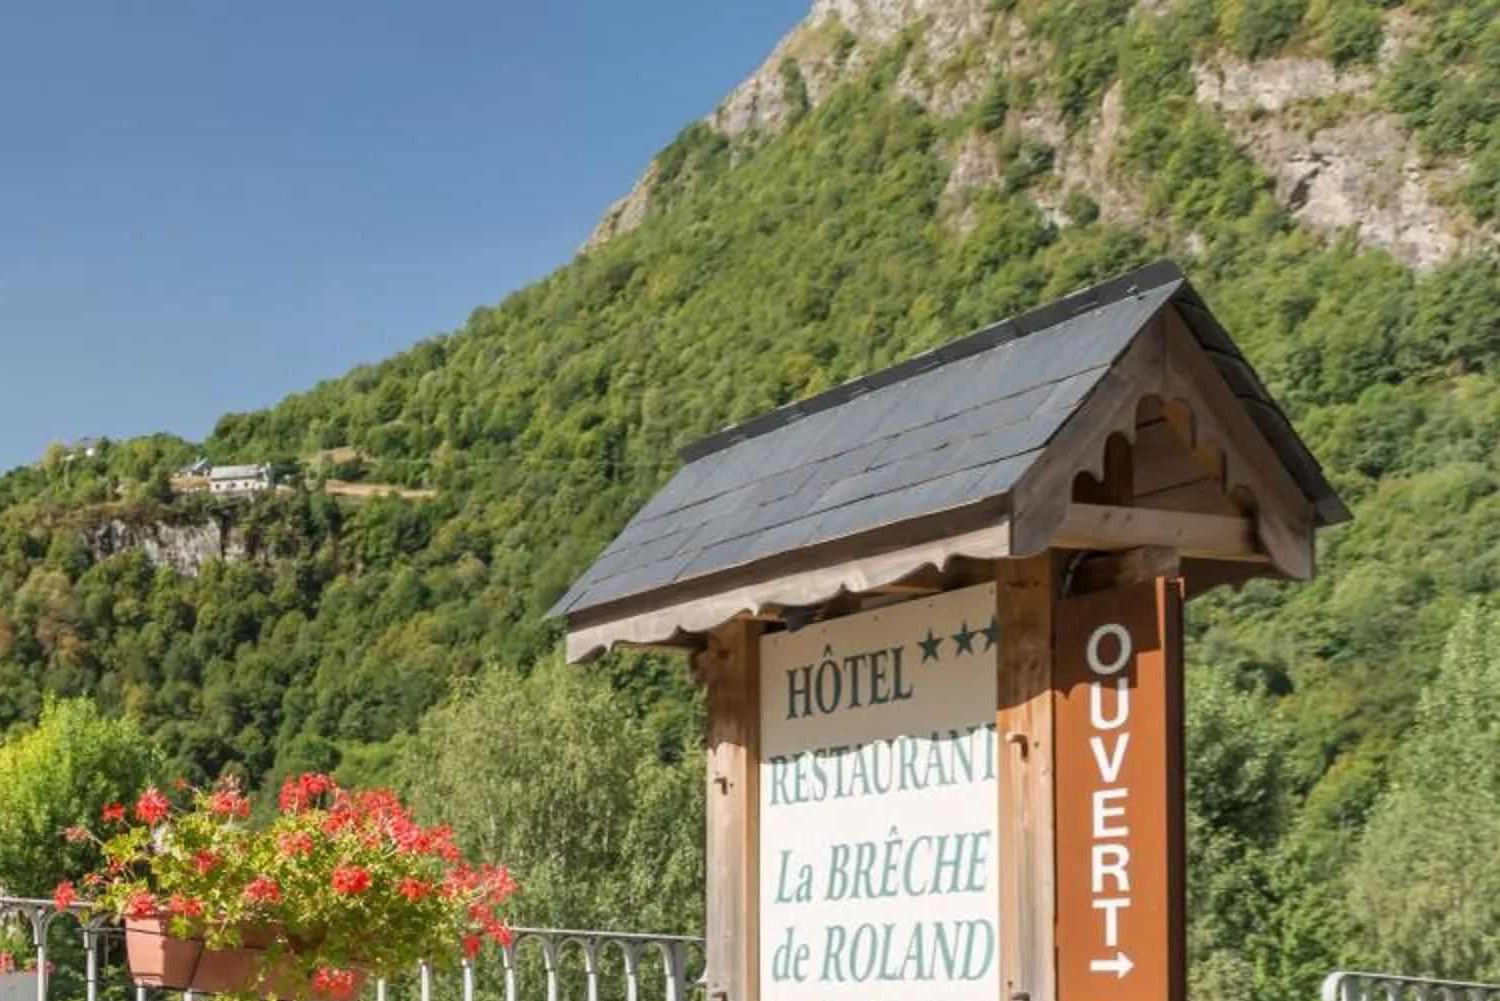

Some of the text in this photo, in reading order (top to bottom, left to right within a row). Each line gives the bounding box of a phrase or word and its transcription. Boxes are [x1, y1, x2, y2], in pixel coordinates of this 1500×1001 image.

[785, 645, 913, 720] HÔTEL
[768, 722, 997, 807] RESTAURANT
[1086, 623, 1133, 947] OUVERT
[774, 848, 814, 905] La
[771, 918, 996, 983] de ROLAND
